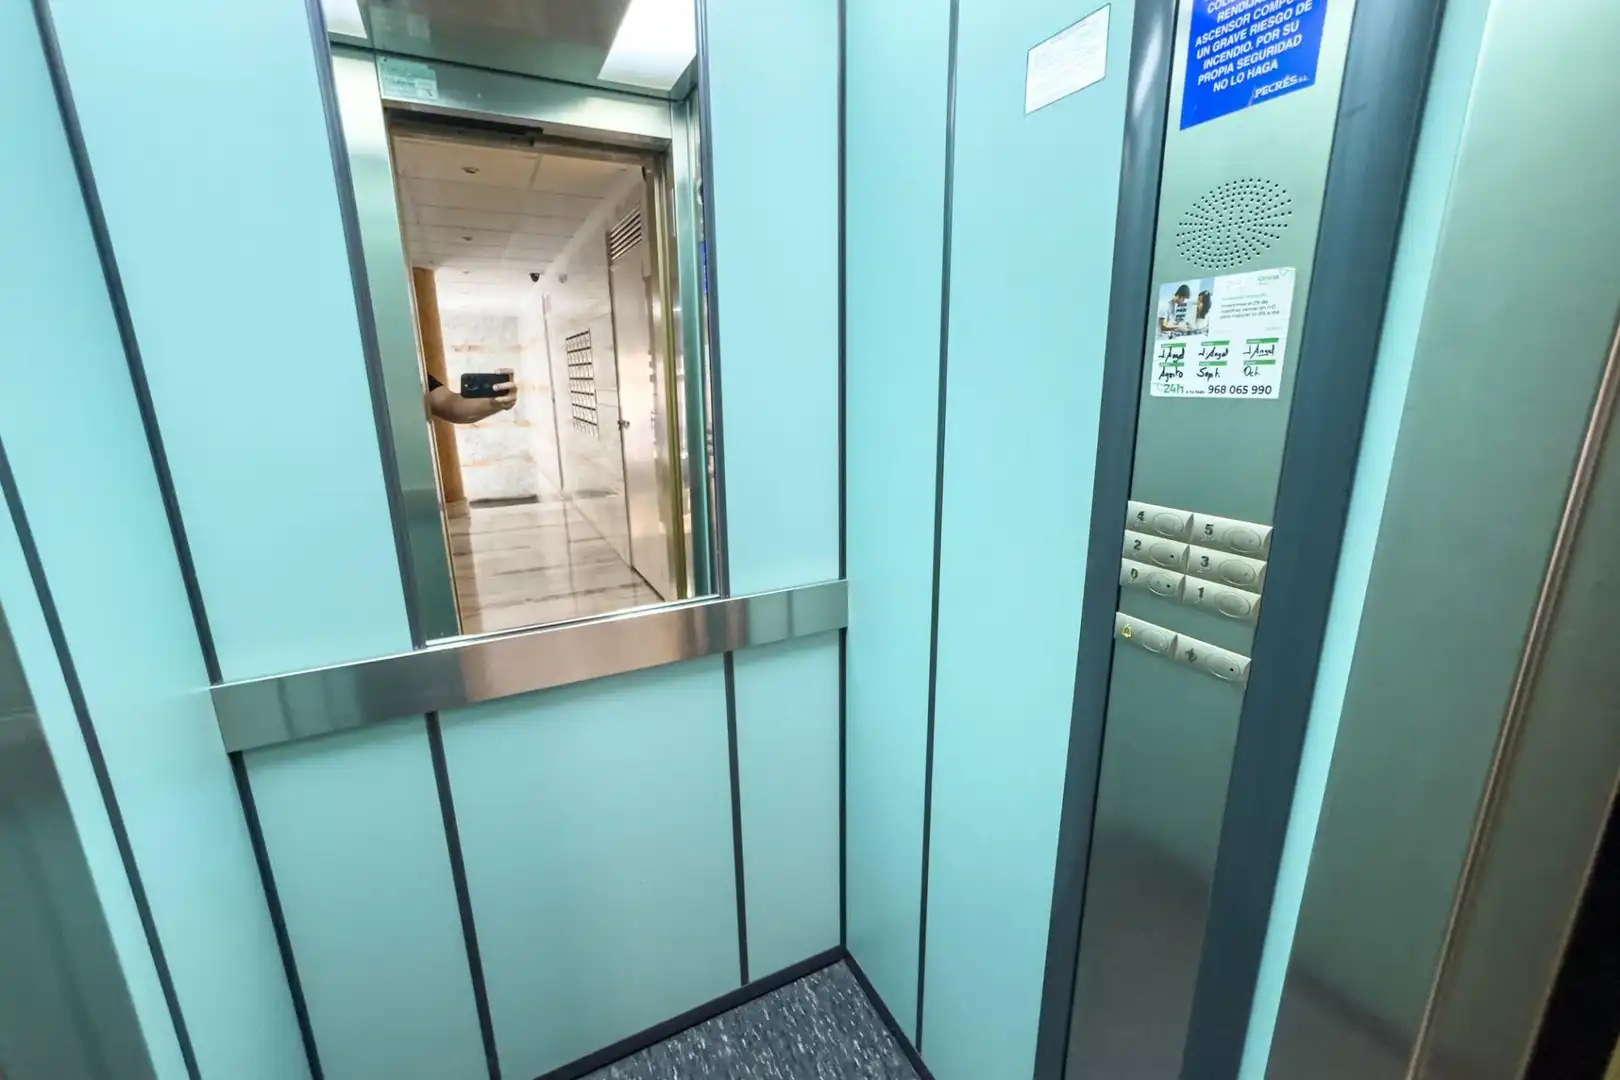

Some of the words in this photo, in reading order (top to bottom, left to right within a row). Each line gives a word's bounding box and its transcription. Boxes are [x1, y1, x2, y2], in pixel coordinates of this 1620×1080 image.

[1195, 13, 1250, 47] ASCENSOR
[1196, 44, 1210, 59] UN
[1213, 28, 1247, 52] GRAVE
[1249, 8, 1293, 37] RIESGO
[1295, 0, 1313, 16] DE
[1256, 28, 1280, 48] POR
[1282, 20, 1300, 36] SU
[1198, 62, 1234, 85] PROPIA
[1236, 34, 1302, 69] SEGURIDAD
[1213, 77, 1228, 92] NO
[1230, 72, 1245, 86] LO
[1247, 59, 1278, 80] HAGA
[1163, 384, 1184, 394] 24h
[1208, 385, 1226, 394] 968
[1229, 385, 1248, 394] 065
[1251, 385, 1272, 394] 990
[1136, 511, 1145, 522] 4
[1204, 524, 1214, 536] 5
[1133, 539, 1142, 551] 2
[1201, 555, 1210, 567] 3
[1130, 568, 1139, 579] 0
[1198, 587, 1205, 599] 1
